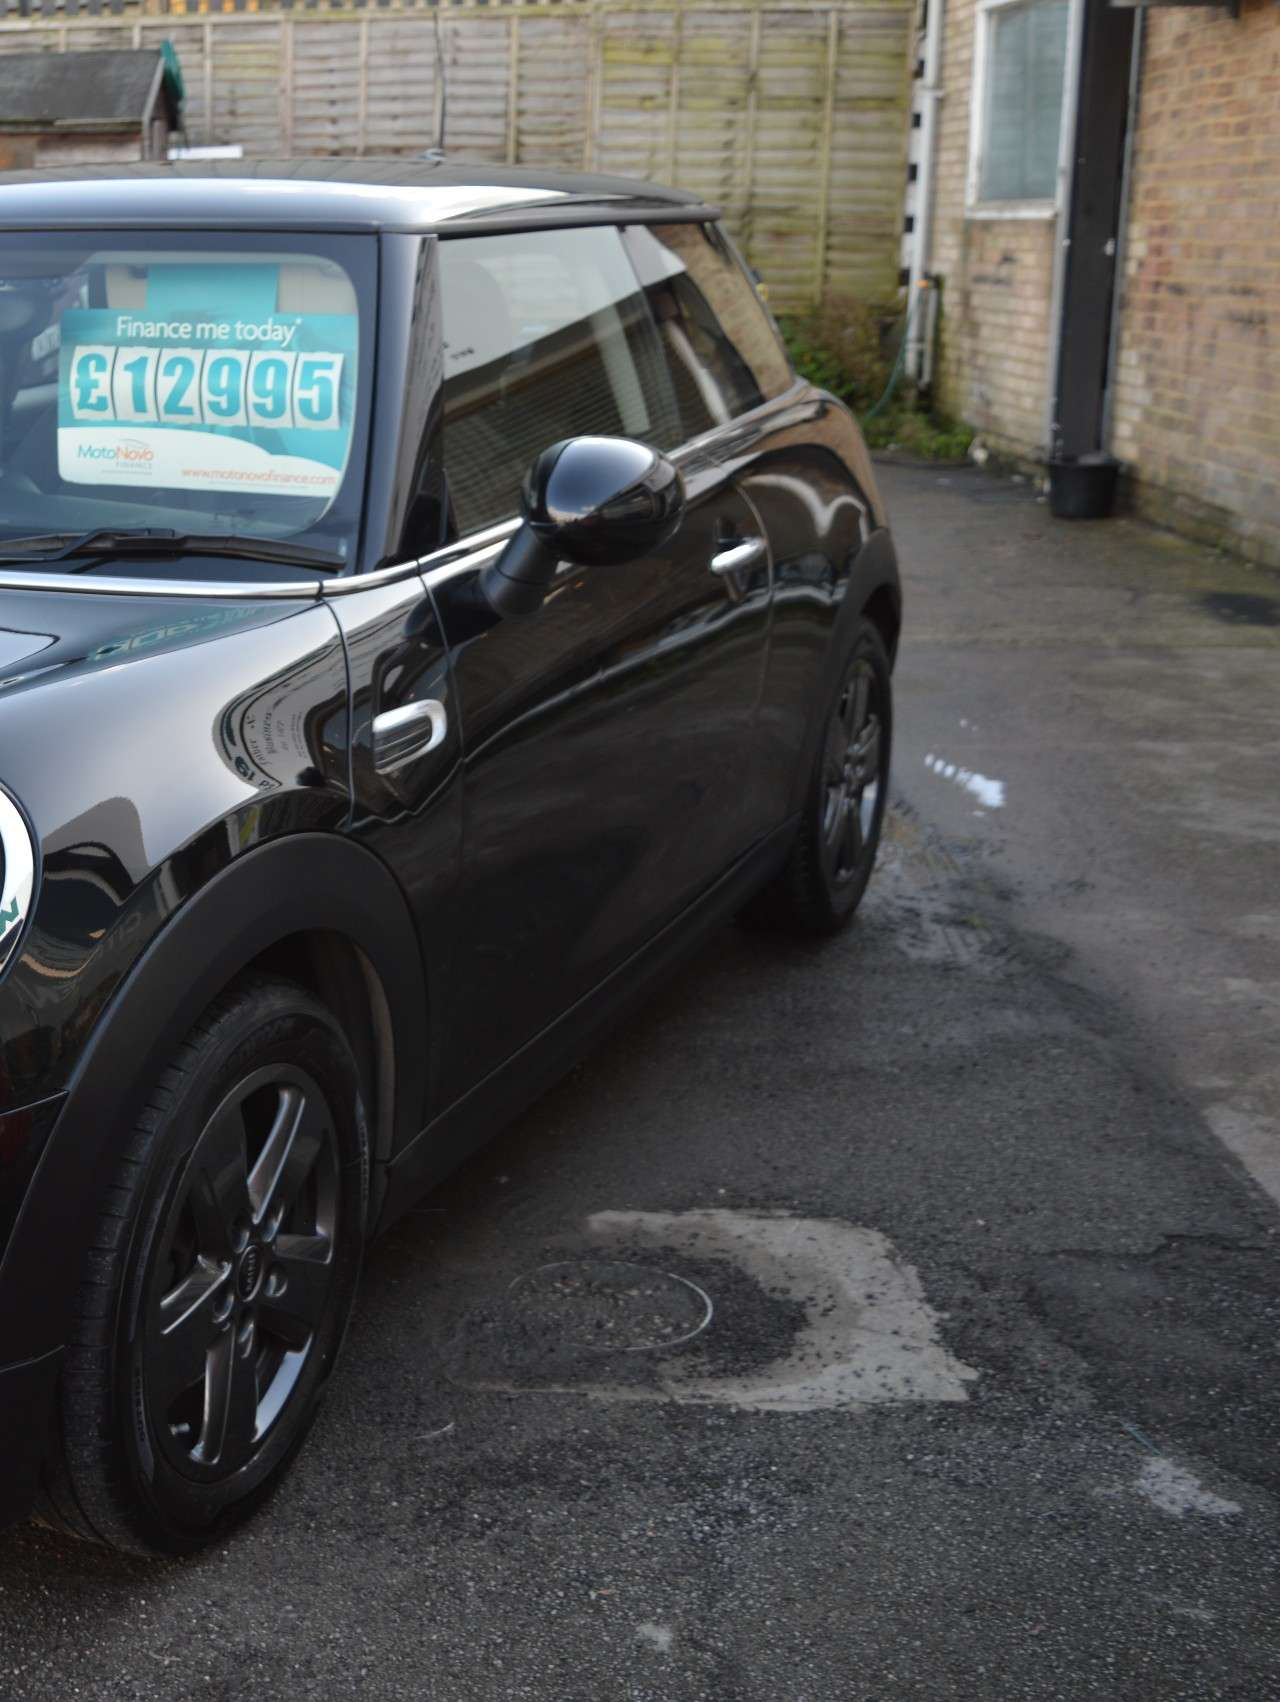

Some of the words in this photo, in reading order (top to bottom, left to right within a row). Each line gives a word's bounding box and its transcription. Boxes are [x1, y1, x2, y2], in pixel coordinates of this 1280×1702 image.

[116, 316, 191, 339] Finance
[196, 322, 230, 339] me
[75, 353, 334, 421] £12995
[78, 445, 154, 461] MotoNovo
